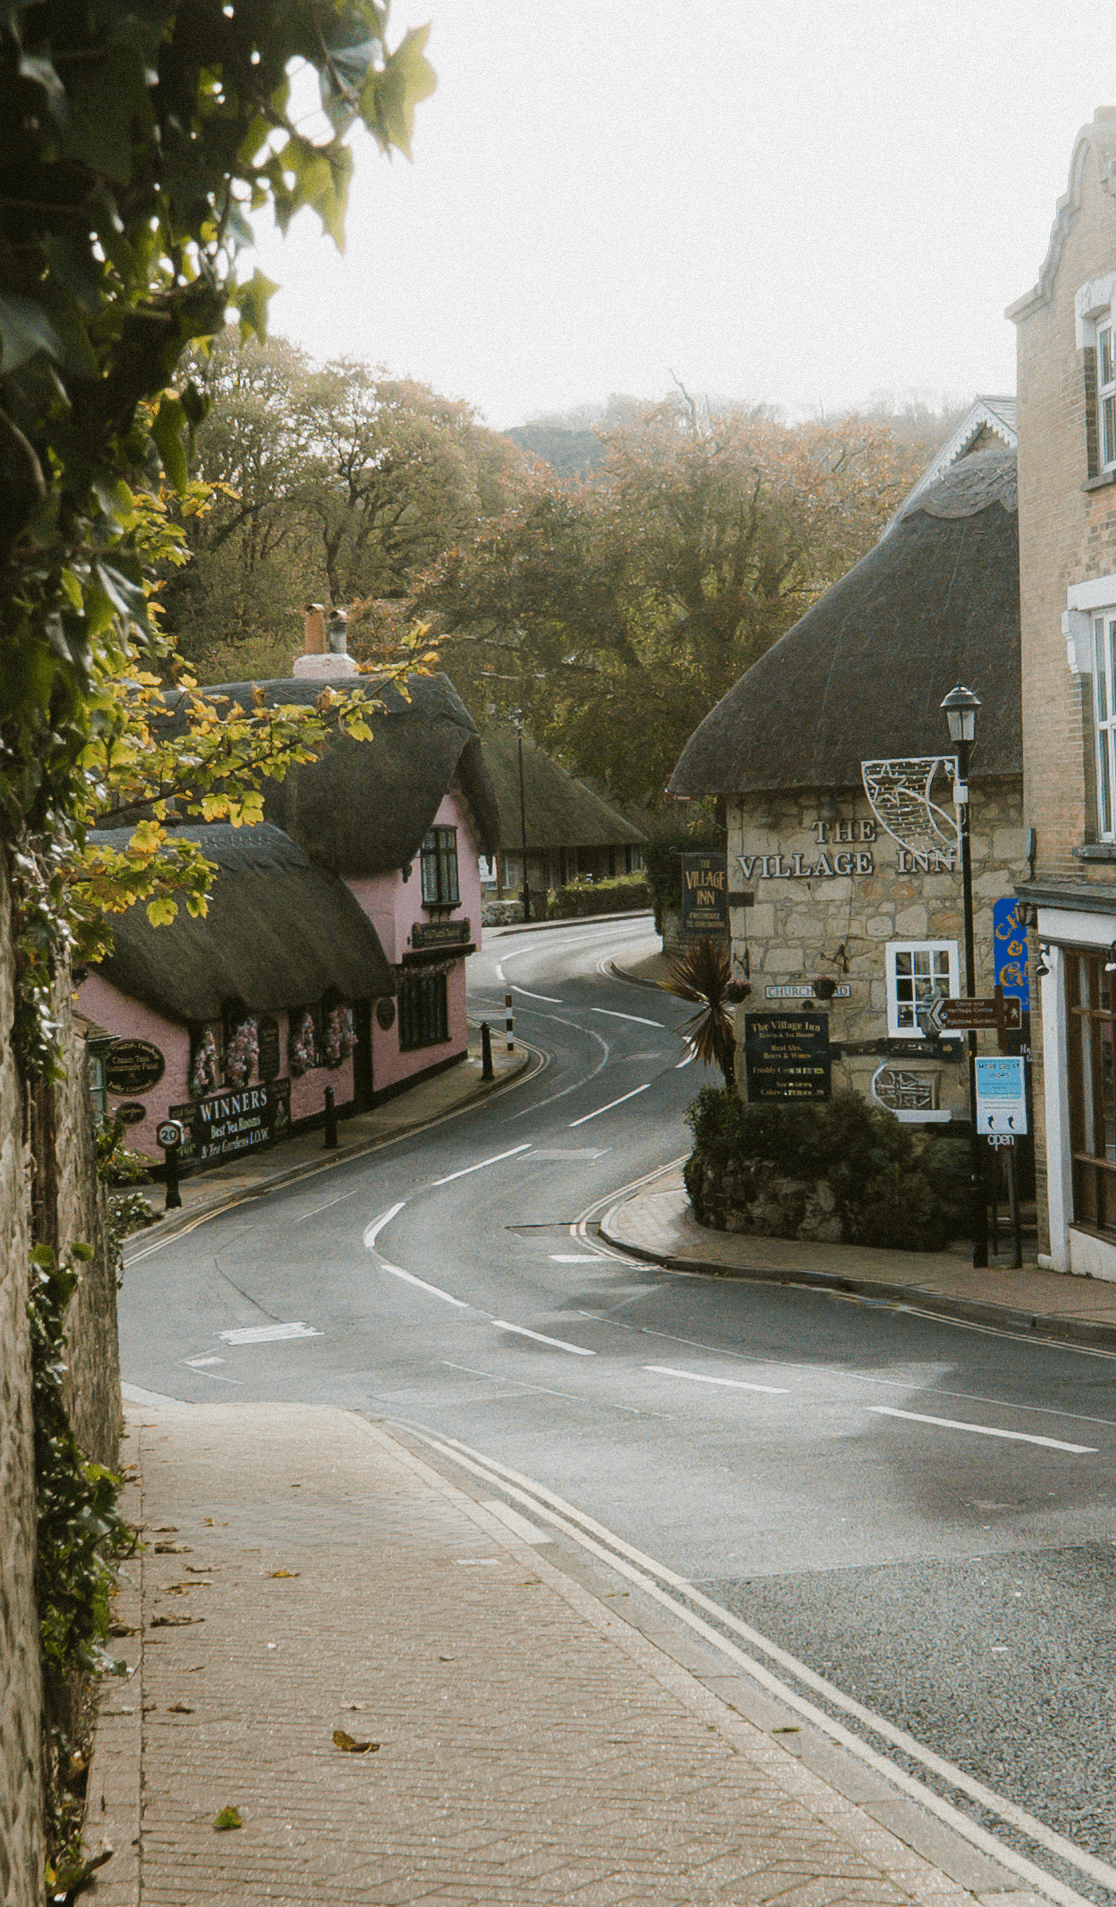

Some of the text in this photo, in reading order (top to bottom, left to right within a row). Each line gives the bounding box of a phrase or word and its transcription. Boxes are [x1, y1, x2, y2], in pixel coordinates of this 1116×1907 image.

[812, 819, 877, 844] THE
[736, 849, 955, 879] VILLAGE INN
[685, 871, 725, 890] VILLAGE
[696, 890, 715, 905] INN
[750, 1021, 821, 1033] The Village Inn
[200, 1088, 267, 1122] WINNERS
[160, 1129, 177, 1140] 20
[211, 1116, 261, 1139] Best Tea Rooms
[209, 1143, 221, 1157] Tea
[987, 1133, 1015, 1151] open
